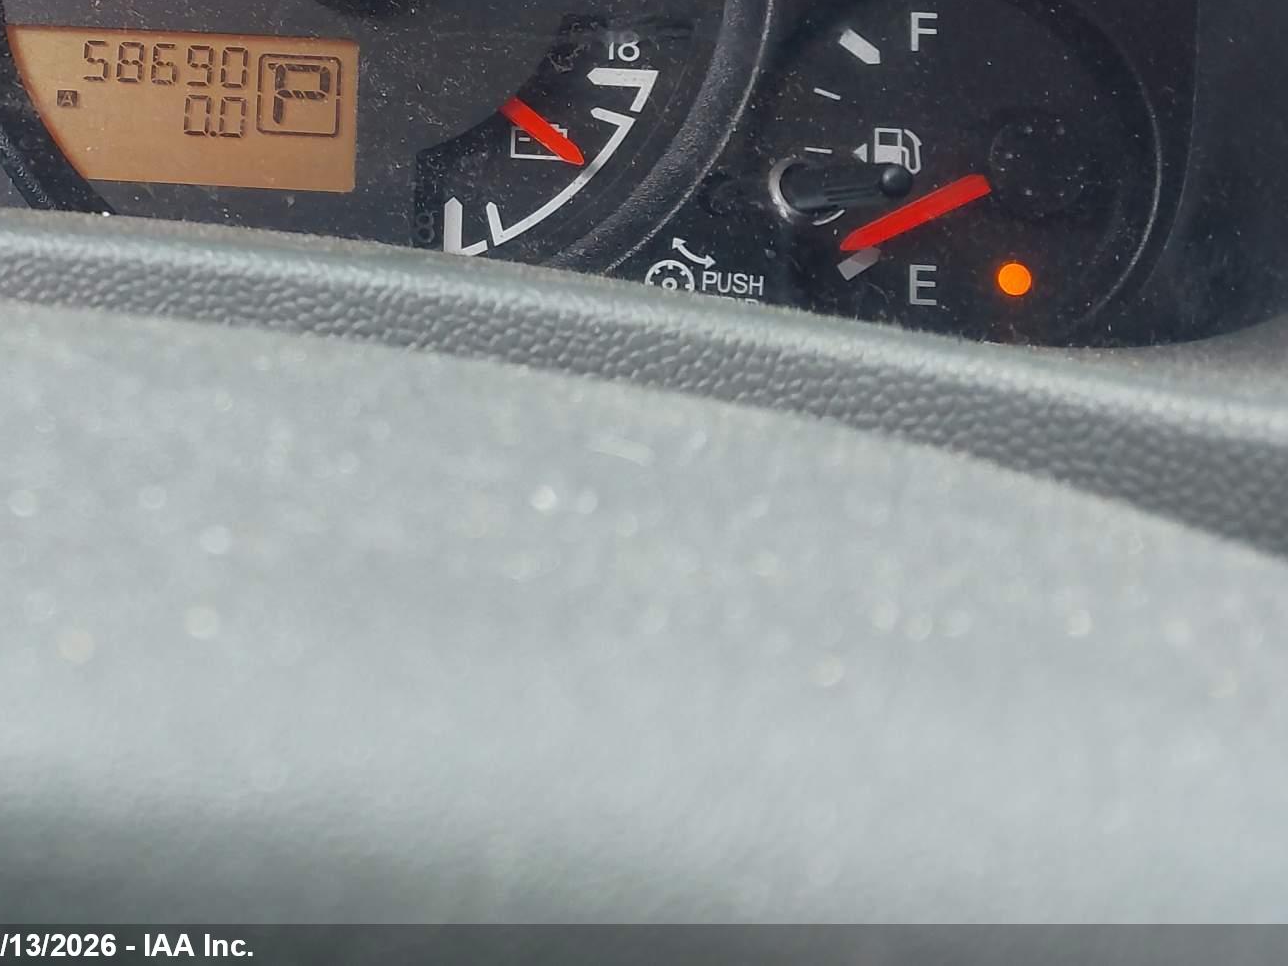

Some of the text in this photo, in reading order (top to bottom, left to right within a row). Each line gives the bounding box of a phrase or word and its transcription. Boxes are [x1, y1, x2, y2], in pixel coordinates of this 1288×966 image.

[911, 12, 938, 51] F
[83, 40, 249, 88] 58690
[268, 63, 330, 124] P
[184, 94, 246, 138] 0.0
[702, 271, 764, 296] PUSH
[910, 265, 937, 305] E
